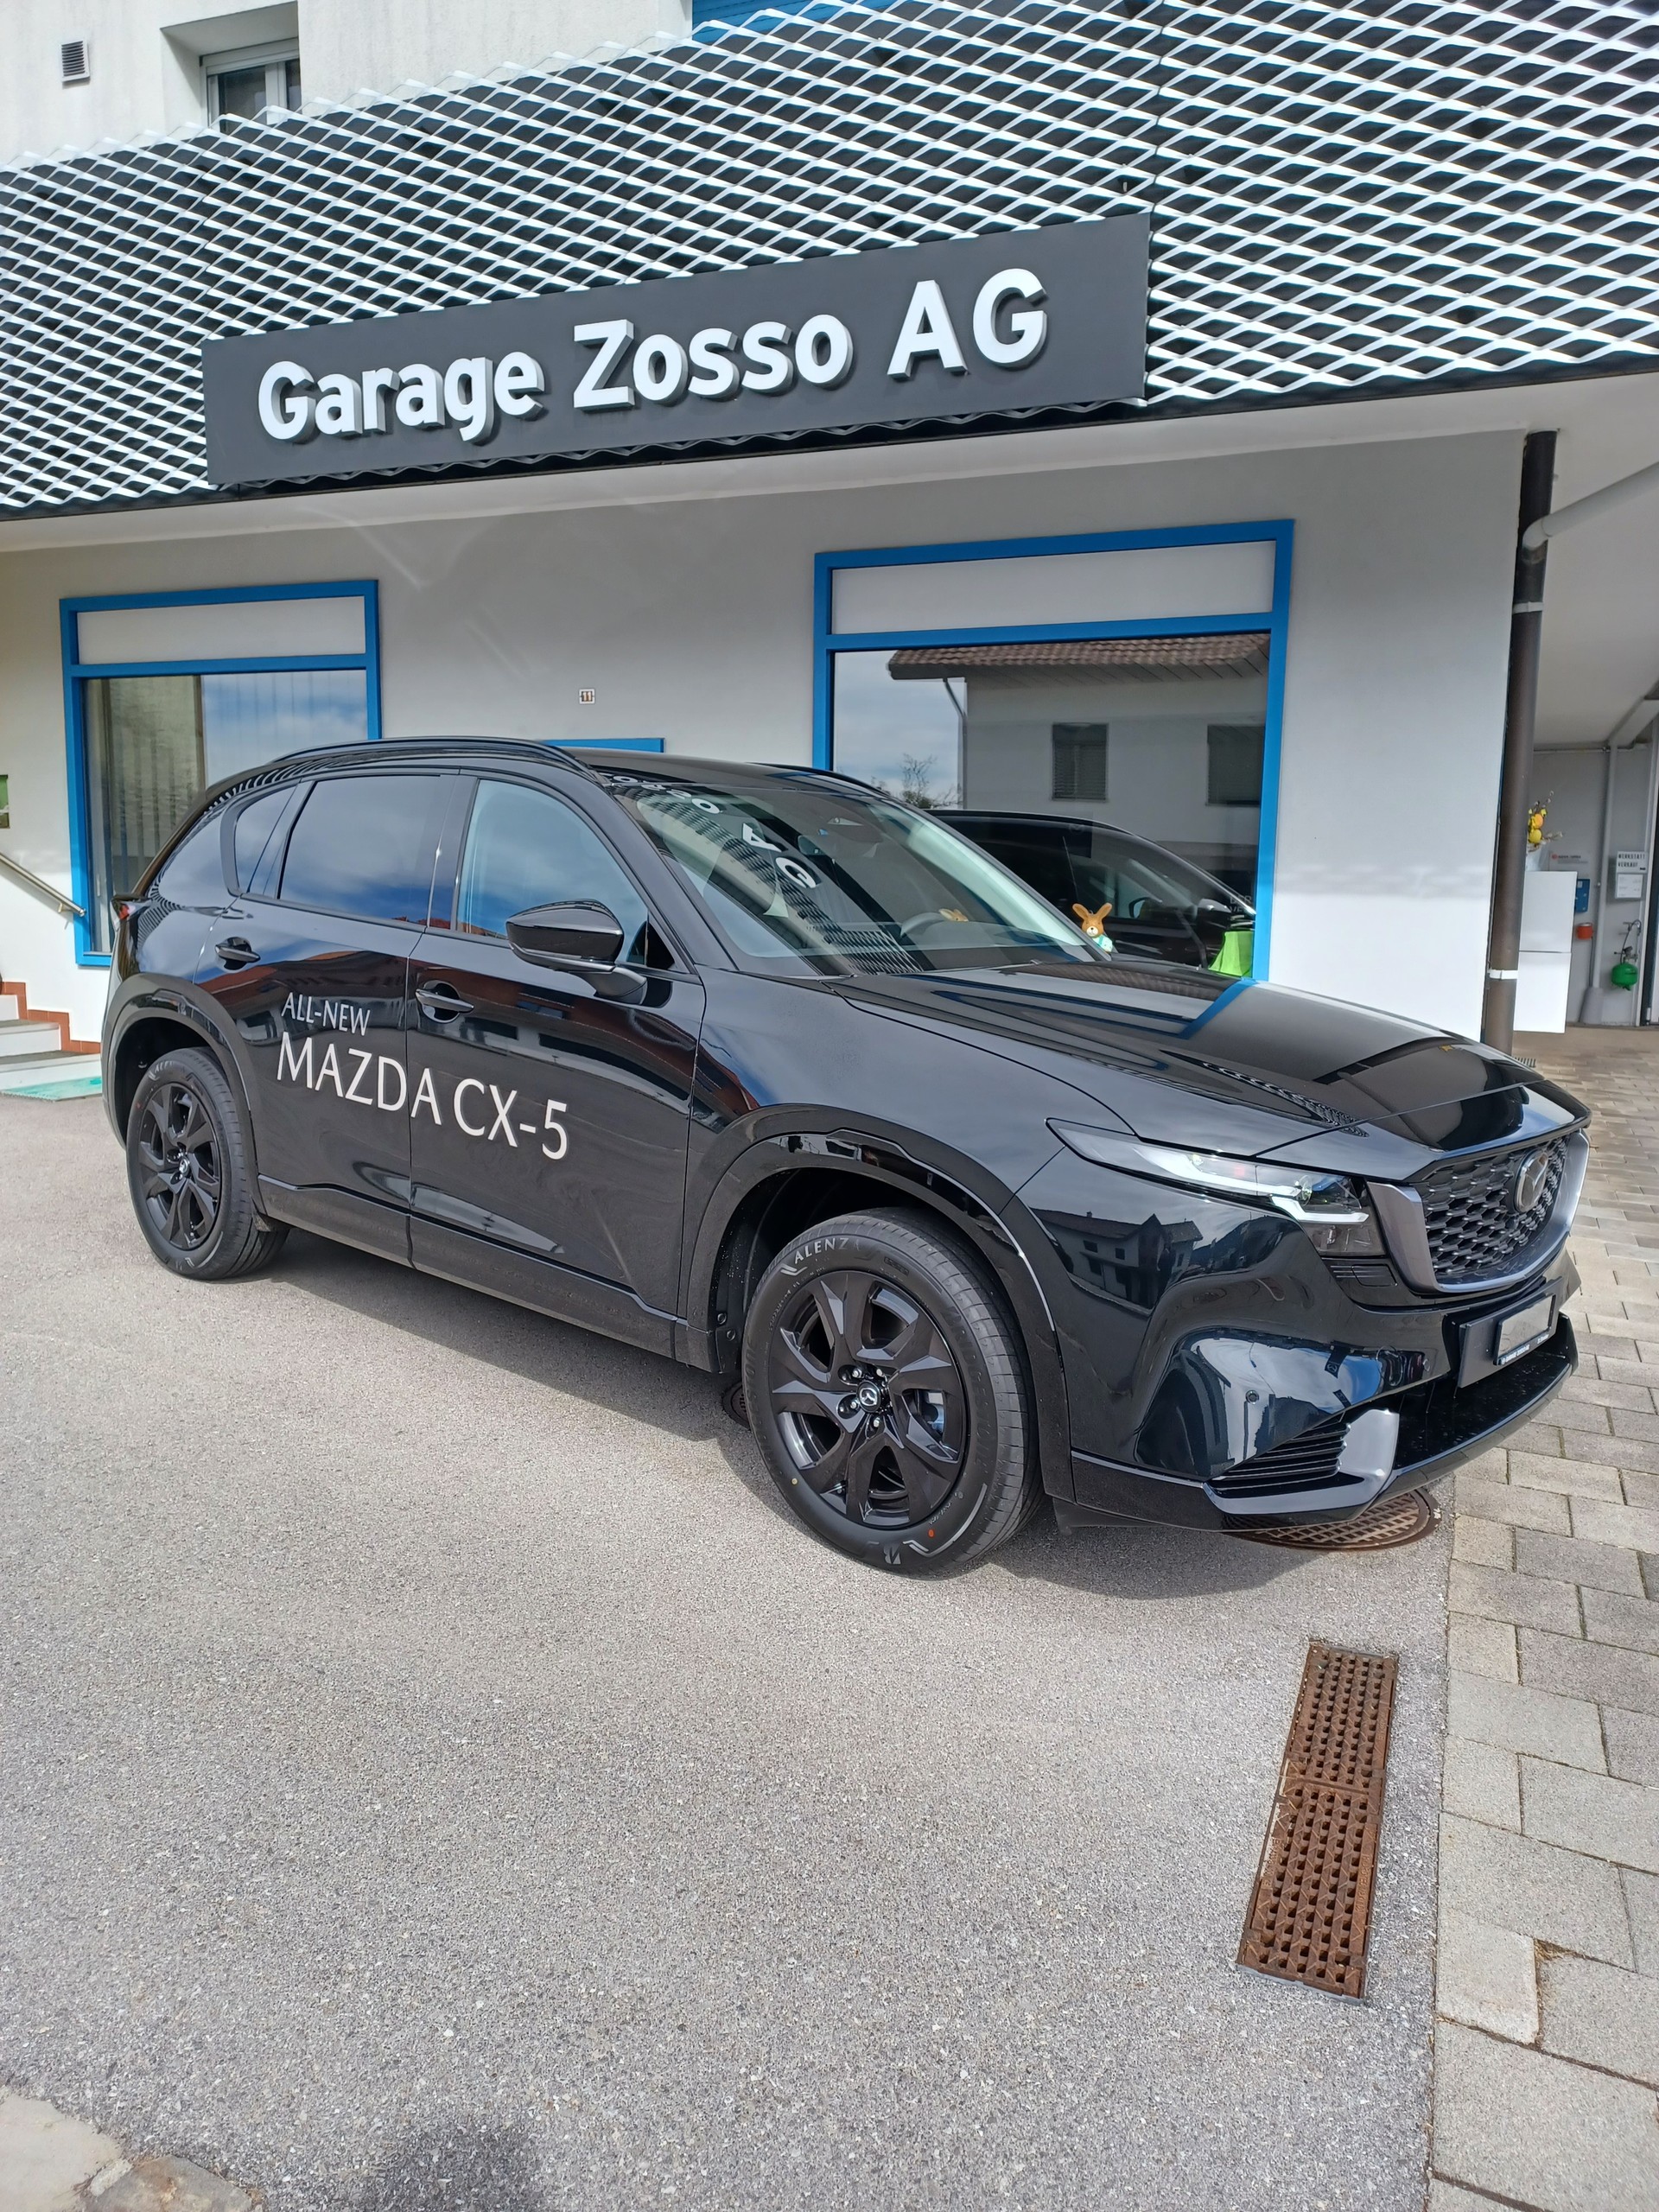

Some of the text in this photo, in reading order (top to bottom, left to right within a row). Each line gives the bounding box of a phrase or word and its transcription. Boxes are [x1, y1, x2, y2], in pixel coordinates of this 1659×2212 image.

[257, 267, 1047, 443] Garage Zosso AG
[281, 992, 371, 1036] ALL-NEW
[276, 1031, 569, 1160] MAZDA CX-5
